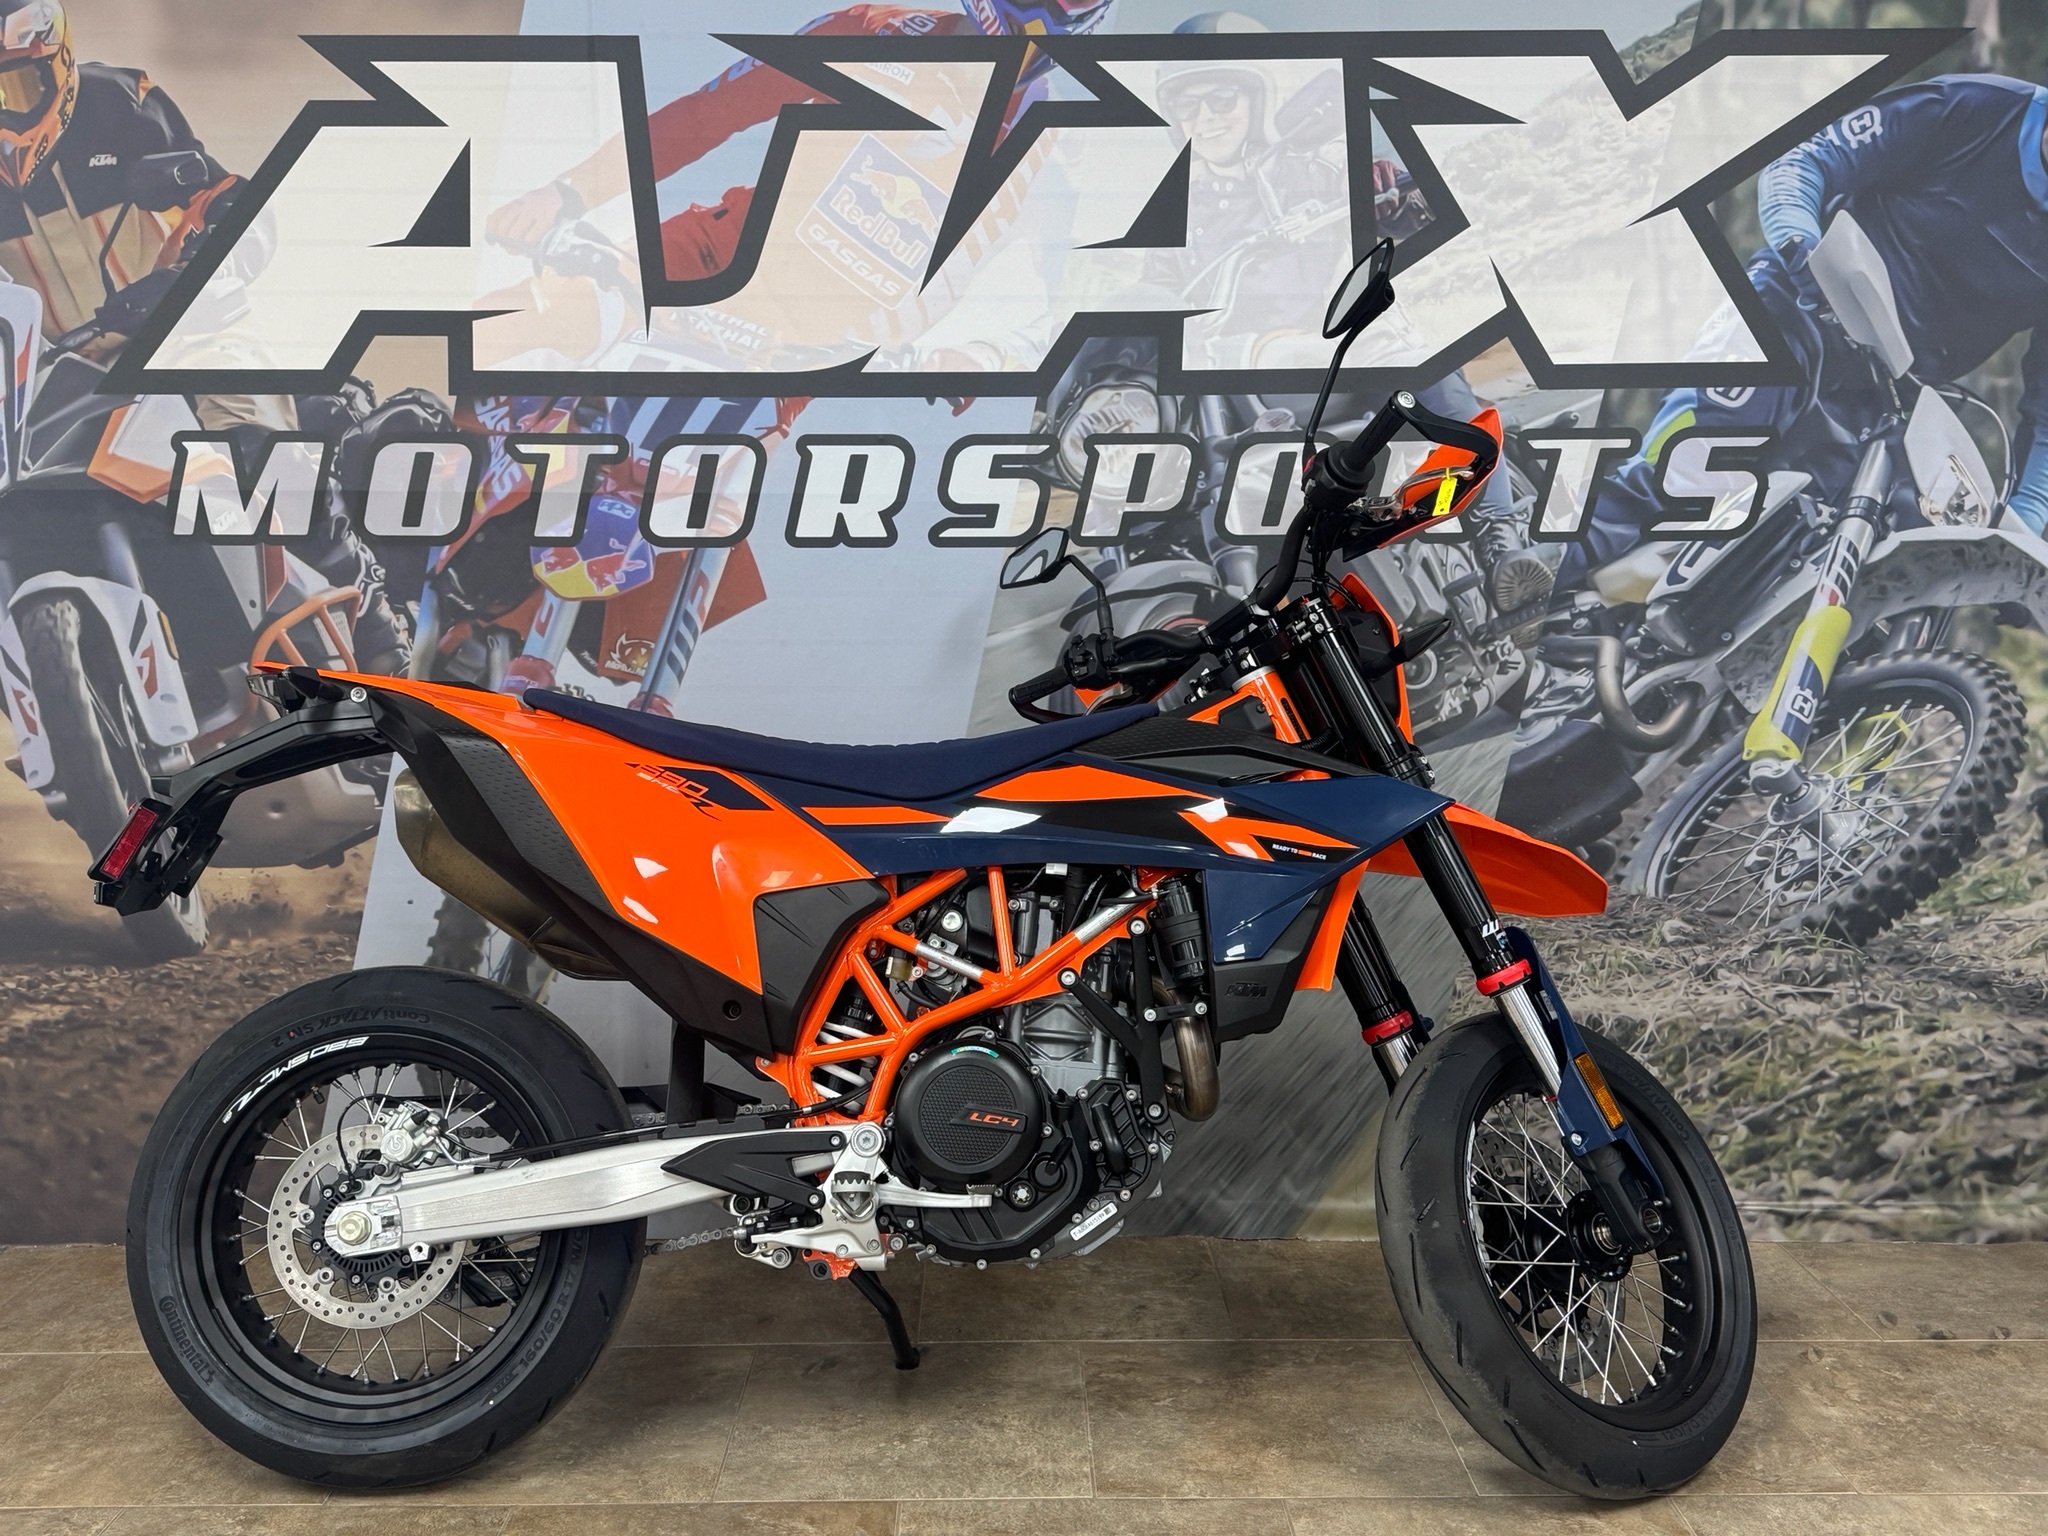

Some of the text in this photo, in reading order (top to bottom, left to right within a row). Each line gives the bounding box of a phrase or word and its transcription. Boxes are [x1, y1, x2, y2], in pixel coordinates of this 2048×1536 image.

[89, 154, 117, 167] KTM
[94, 29, 1974, 394] AJAX
[807, 223, 901, 296] GASGAS
[1271, 843, 1291, 852] READY
[1311, 852, 1327, 860] RACE
[1225, 981, 1268, 998] KTM
[969, 1112, 1020, 1127] LC4
